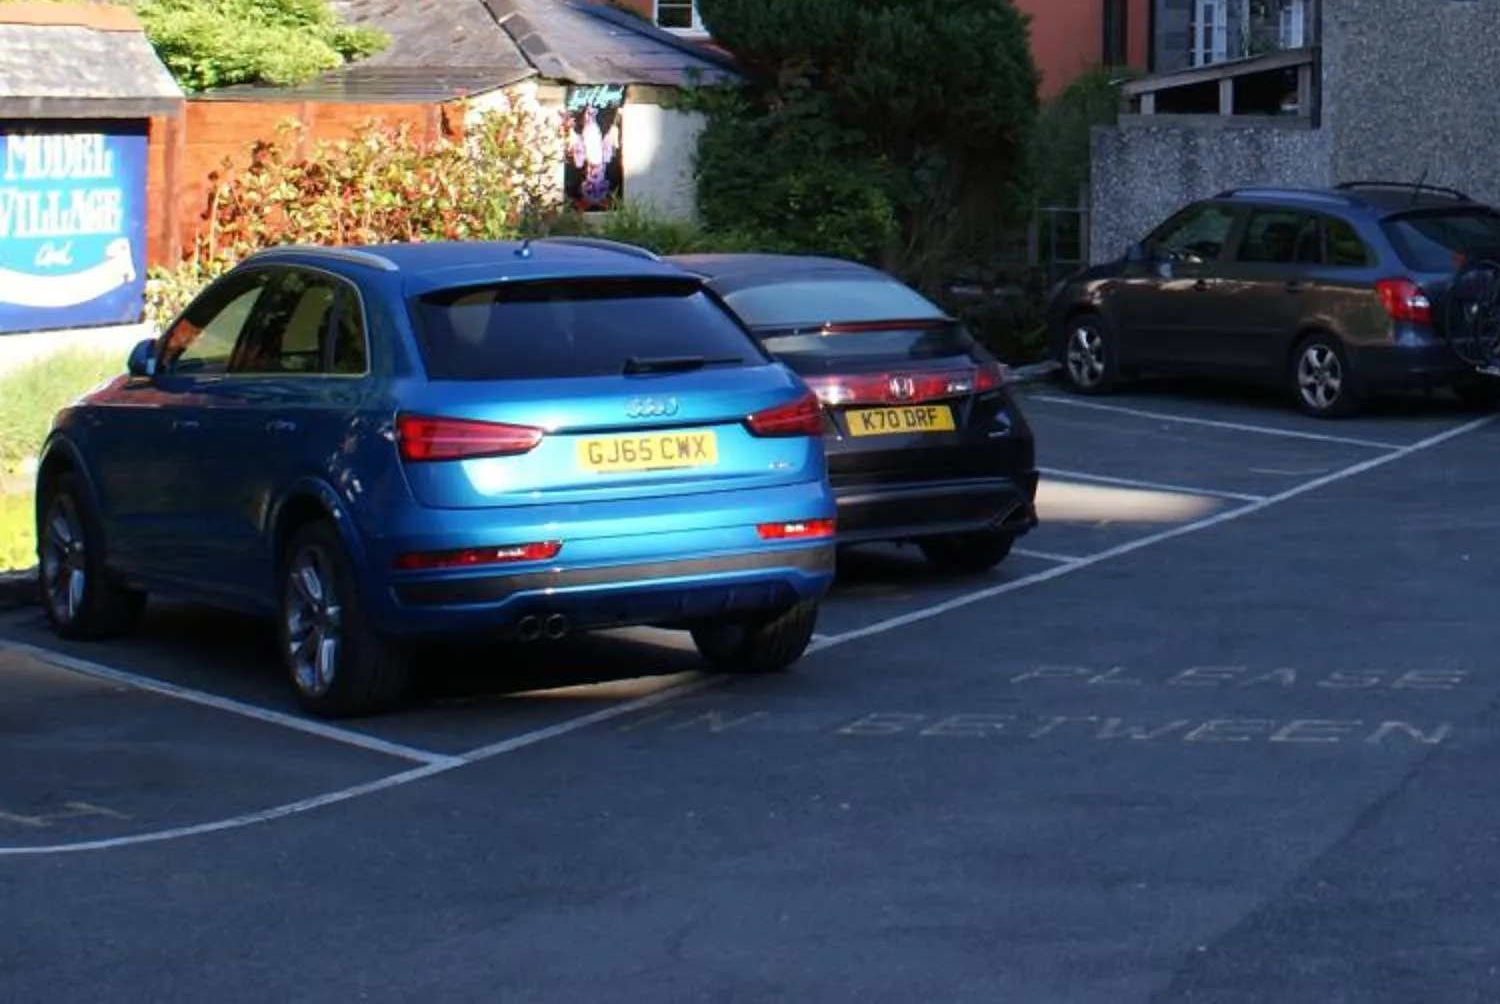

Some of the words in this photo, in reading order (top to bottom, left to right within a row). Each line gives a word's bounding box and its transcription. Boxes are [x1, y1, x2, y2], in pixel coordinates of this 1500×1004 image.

[4, 133, 113, 179] MODEL
[860, 410, 900, 431] K70
[903, 407, 939, 428] DRF
[588, 438, 653, 465] GJ65
[659, 435, 708, 460] CWX
[1010, 665, 1468, 691] PLEASE
[838, 712, 1450, 746] BETWEEN
